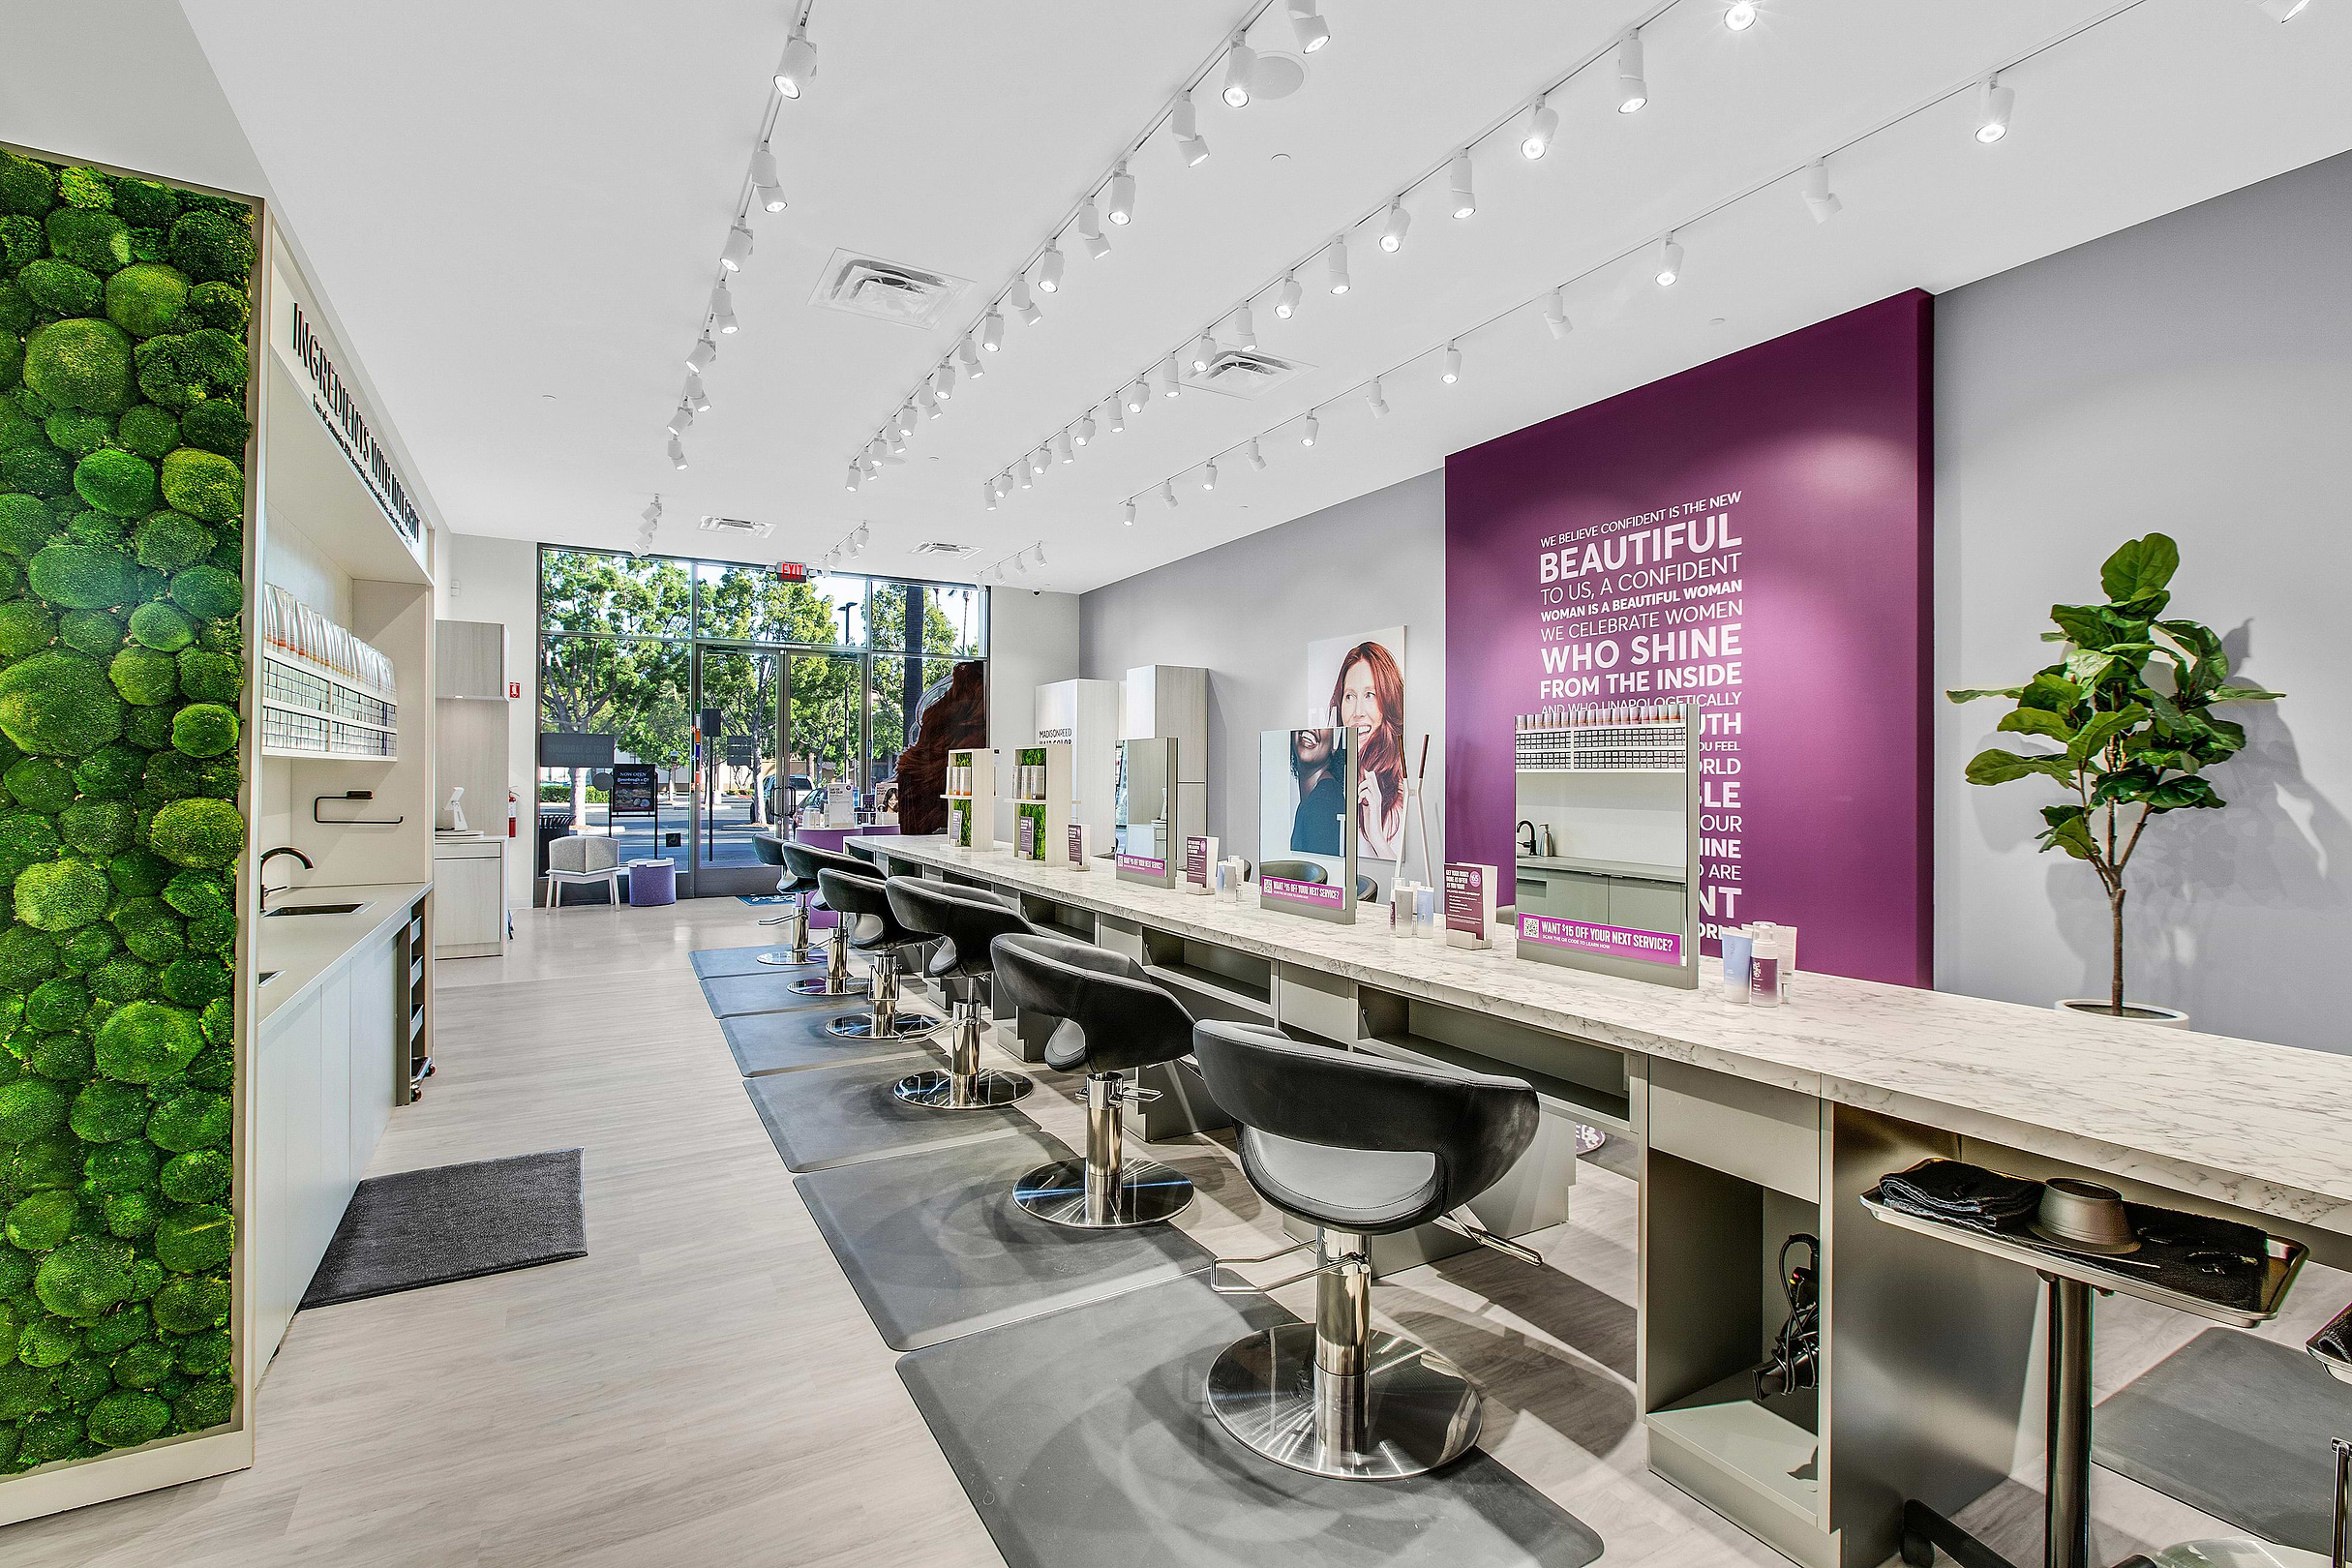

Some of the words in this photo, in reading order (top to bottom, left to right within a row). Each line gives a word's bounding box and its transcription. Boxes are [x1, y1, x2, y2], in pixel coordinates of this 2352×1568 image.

[292, 302, 369, 462] INGREDIENTS
[370, 437, 391, 498] WITH
[1540, 535, 1557, 549] WE
[1558, 526, 1598, 545] BELIEVE
[1601, 508, 1667, 534] CONFIDENT
[1669, 505, 1679, 519] IS
[1682, 498, 1706, 516] THE
[1710, 490, 1742, 510] NEW
[1540, 512, 1742, 584] BEAUTIFUL
[781, 562, 803, 580] EXIT
[1540, 587, 1563, 606] TO
[1569, 581, 1595, 600] US,
[1600, 578, 1613, 596] A
[1618, 552, 1742, 591] CONFIDENT
[1540, 603, 1585, 622] WOMAN
[1588, 602, 1598, 616] IS
[1601, 600, 1610, 614] A
[1612, 589, 1680, 612] BEAUTIFUL
[1683, 579, 1742, 600] WOMAN
[1540, 626, 1564, 643] WE
[1568, 611, 1659, 639] CELEBRATE
[1665, 598, 1742, 625] WOMEN
[1540, 639, 1620, 675] WHO
[1630, 622, 1742, 665] SHINE
[1540, 675, 1600, 700] FROM
[1606, 670, 1650, 695] THE
[1657, 661, 1742, 691] INSIDE
[1714, 740, 1741, 751] FEEL
[1707, 863, 1742, 881] ARE
[1541, 920, 1561, 935] WANT
[1561, 924, 1574, 936] $15
[1575, 926, 1589, 939] OFF
[1589, 928, 1611, 943] YOUR
[1612, 932, 1632, 947] NEXT
[1633, 936, 1674, 952] SERVICE?
